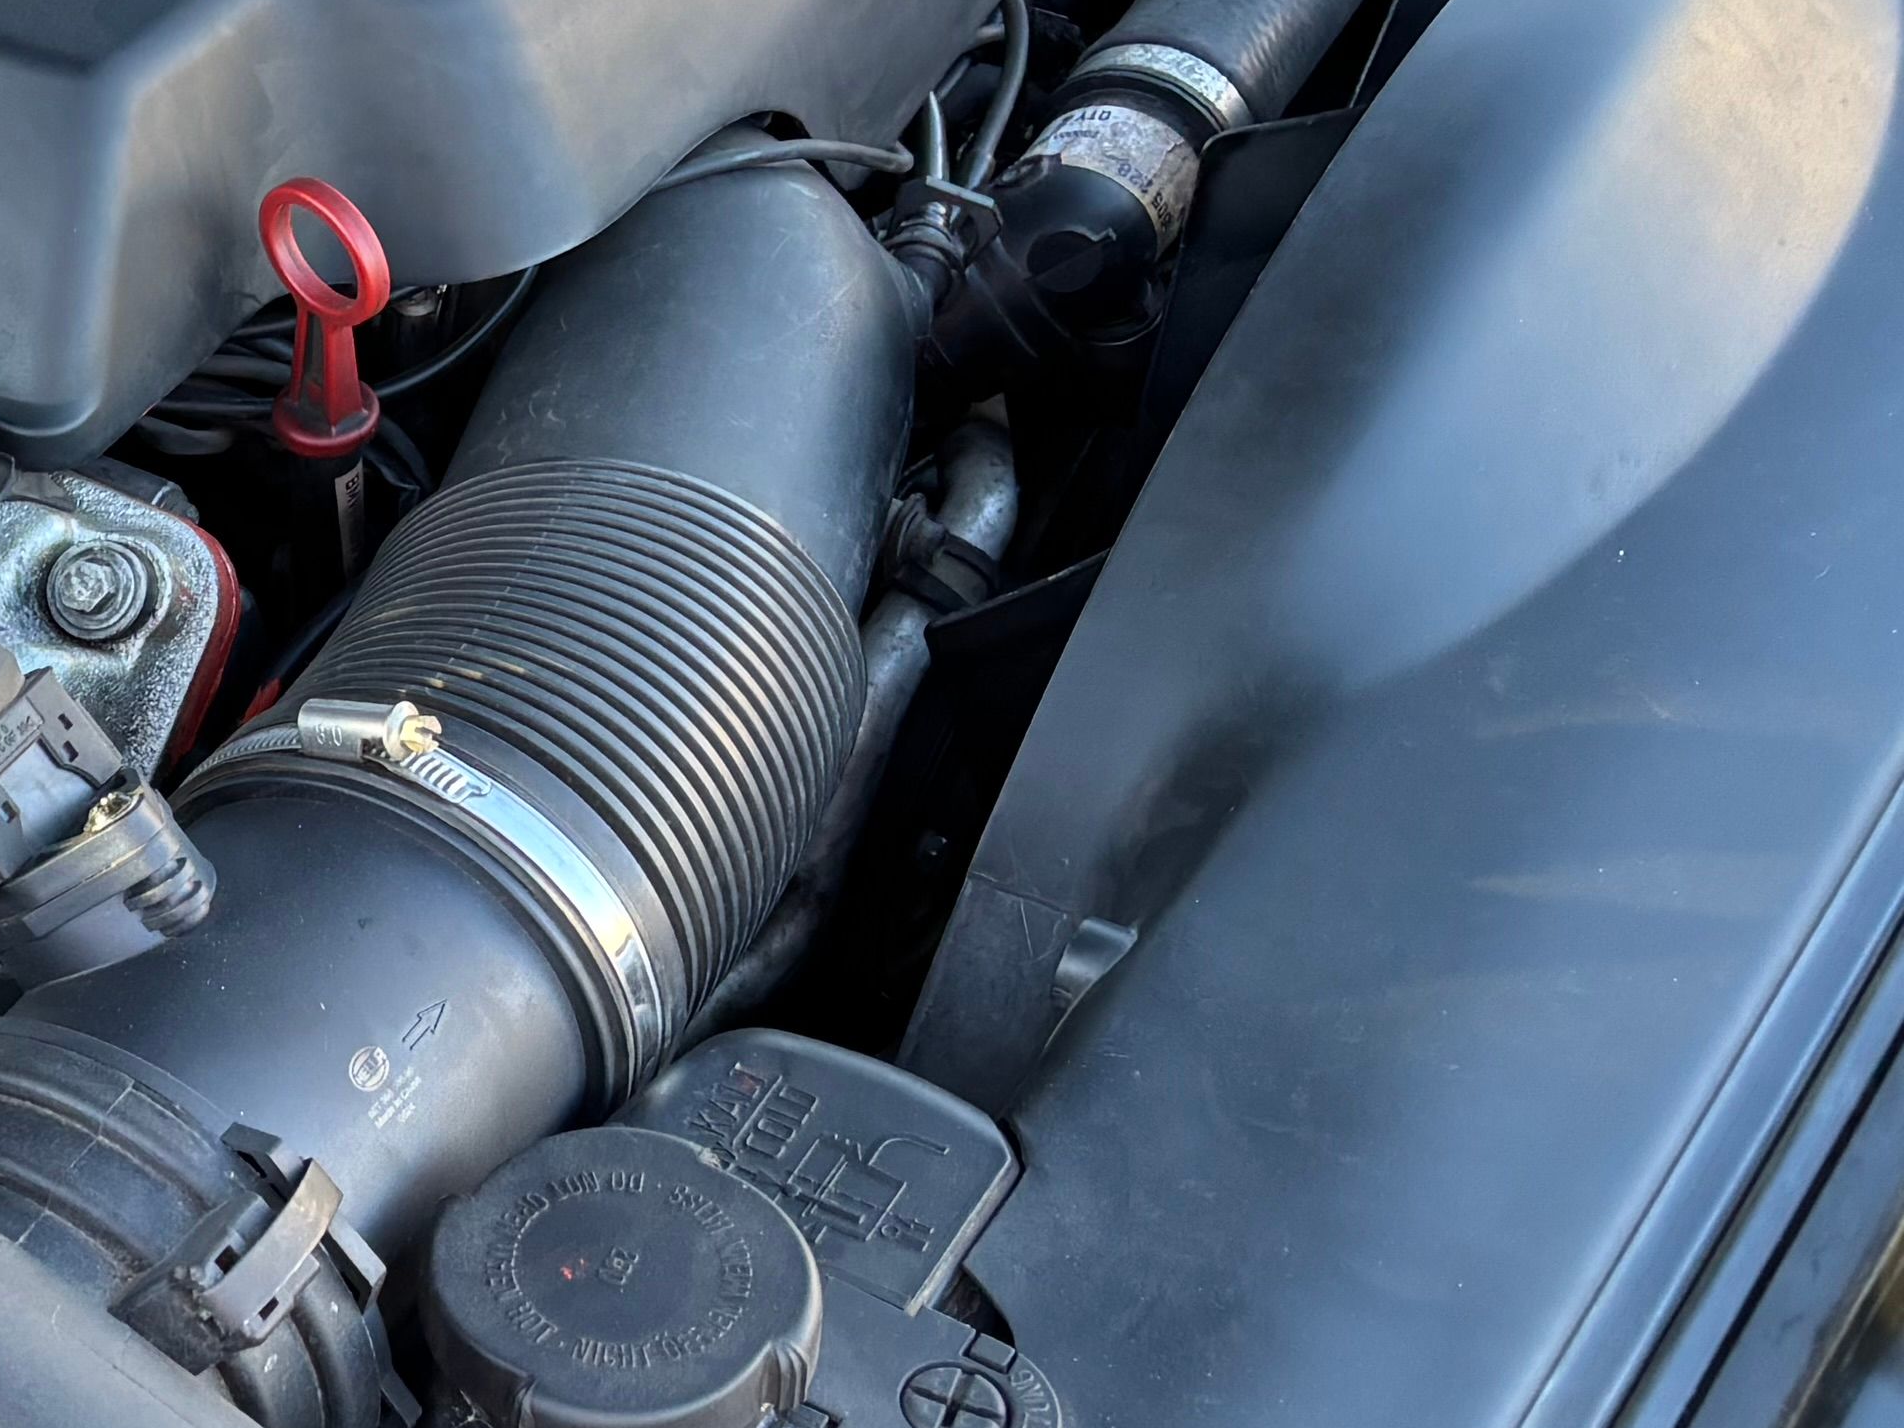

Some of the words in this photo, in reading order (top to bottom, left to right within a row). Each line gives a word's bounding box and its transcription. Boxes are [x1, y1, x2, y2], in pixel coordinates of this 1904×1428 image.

[353, 1048, 389, 1085] HELLA
[684, 1061, 767, 1137] KALT
[745, 1083, 820, 1159] COLD
[549, 1171, 602, 1201] NOT
[610, 1171, 647, 1193] DO
[505, 1300, 559, 1344] HOT
[572, 1337, 654, 1369] NICHT
